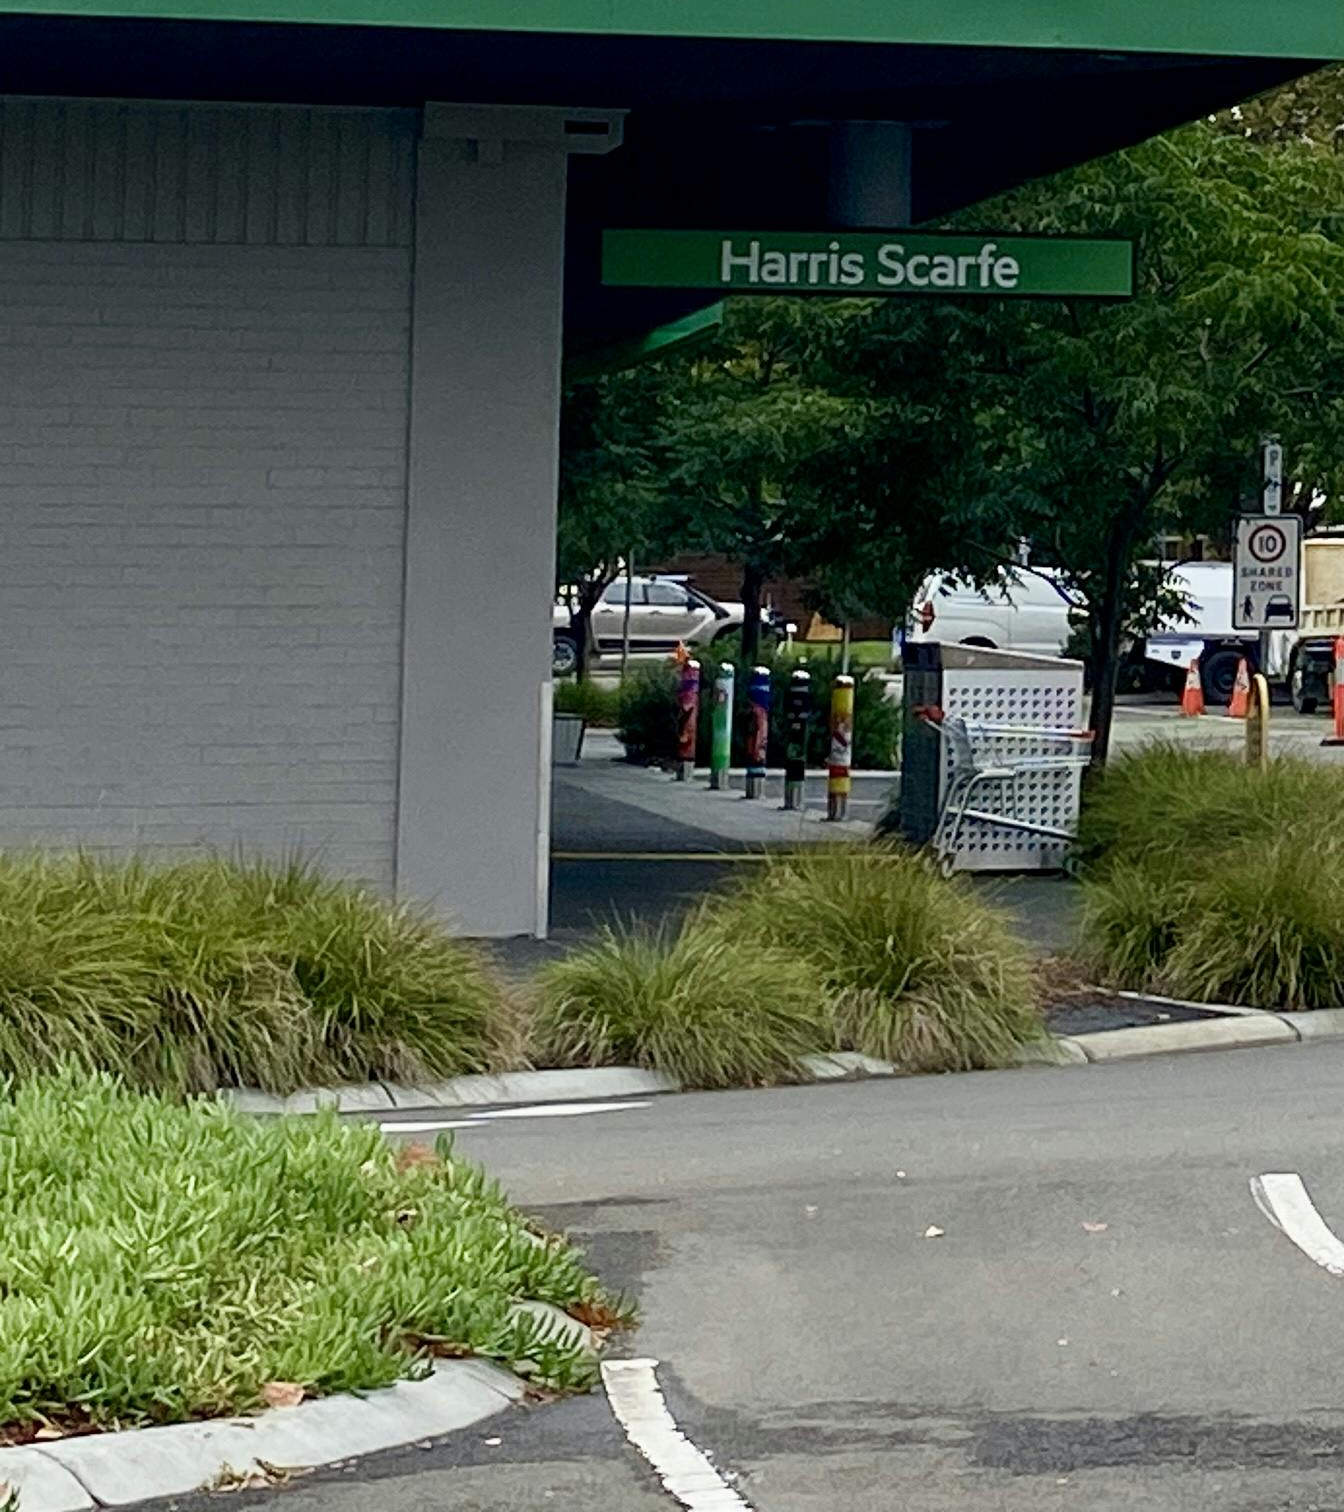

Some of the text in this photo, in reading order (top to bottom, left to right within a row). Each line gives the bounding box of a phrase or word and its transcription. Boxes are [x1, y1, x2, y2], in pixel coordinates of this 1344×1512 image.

[720, 240, 1020, 288] Harris Scarfe
[1258, 535, 1277, 553] 10
[1241, 567, 1293, 578] SHARED
[1251, 580, 1283, 592] ZONE
